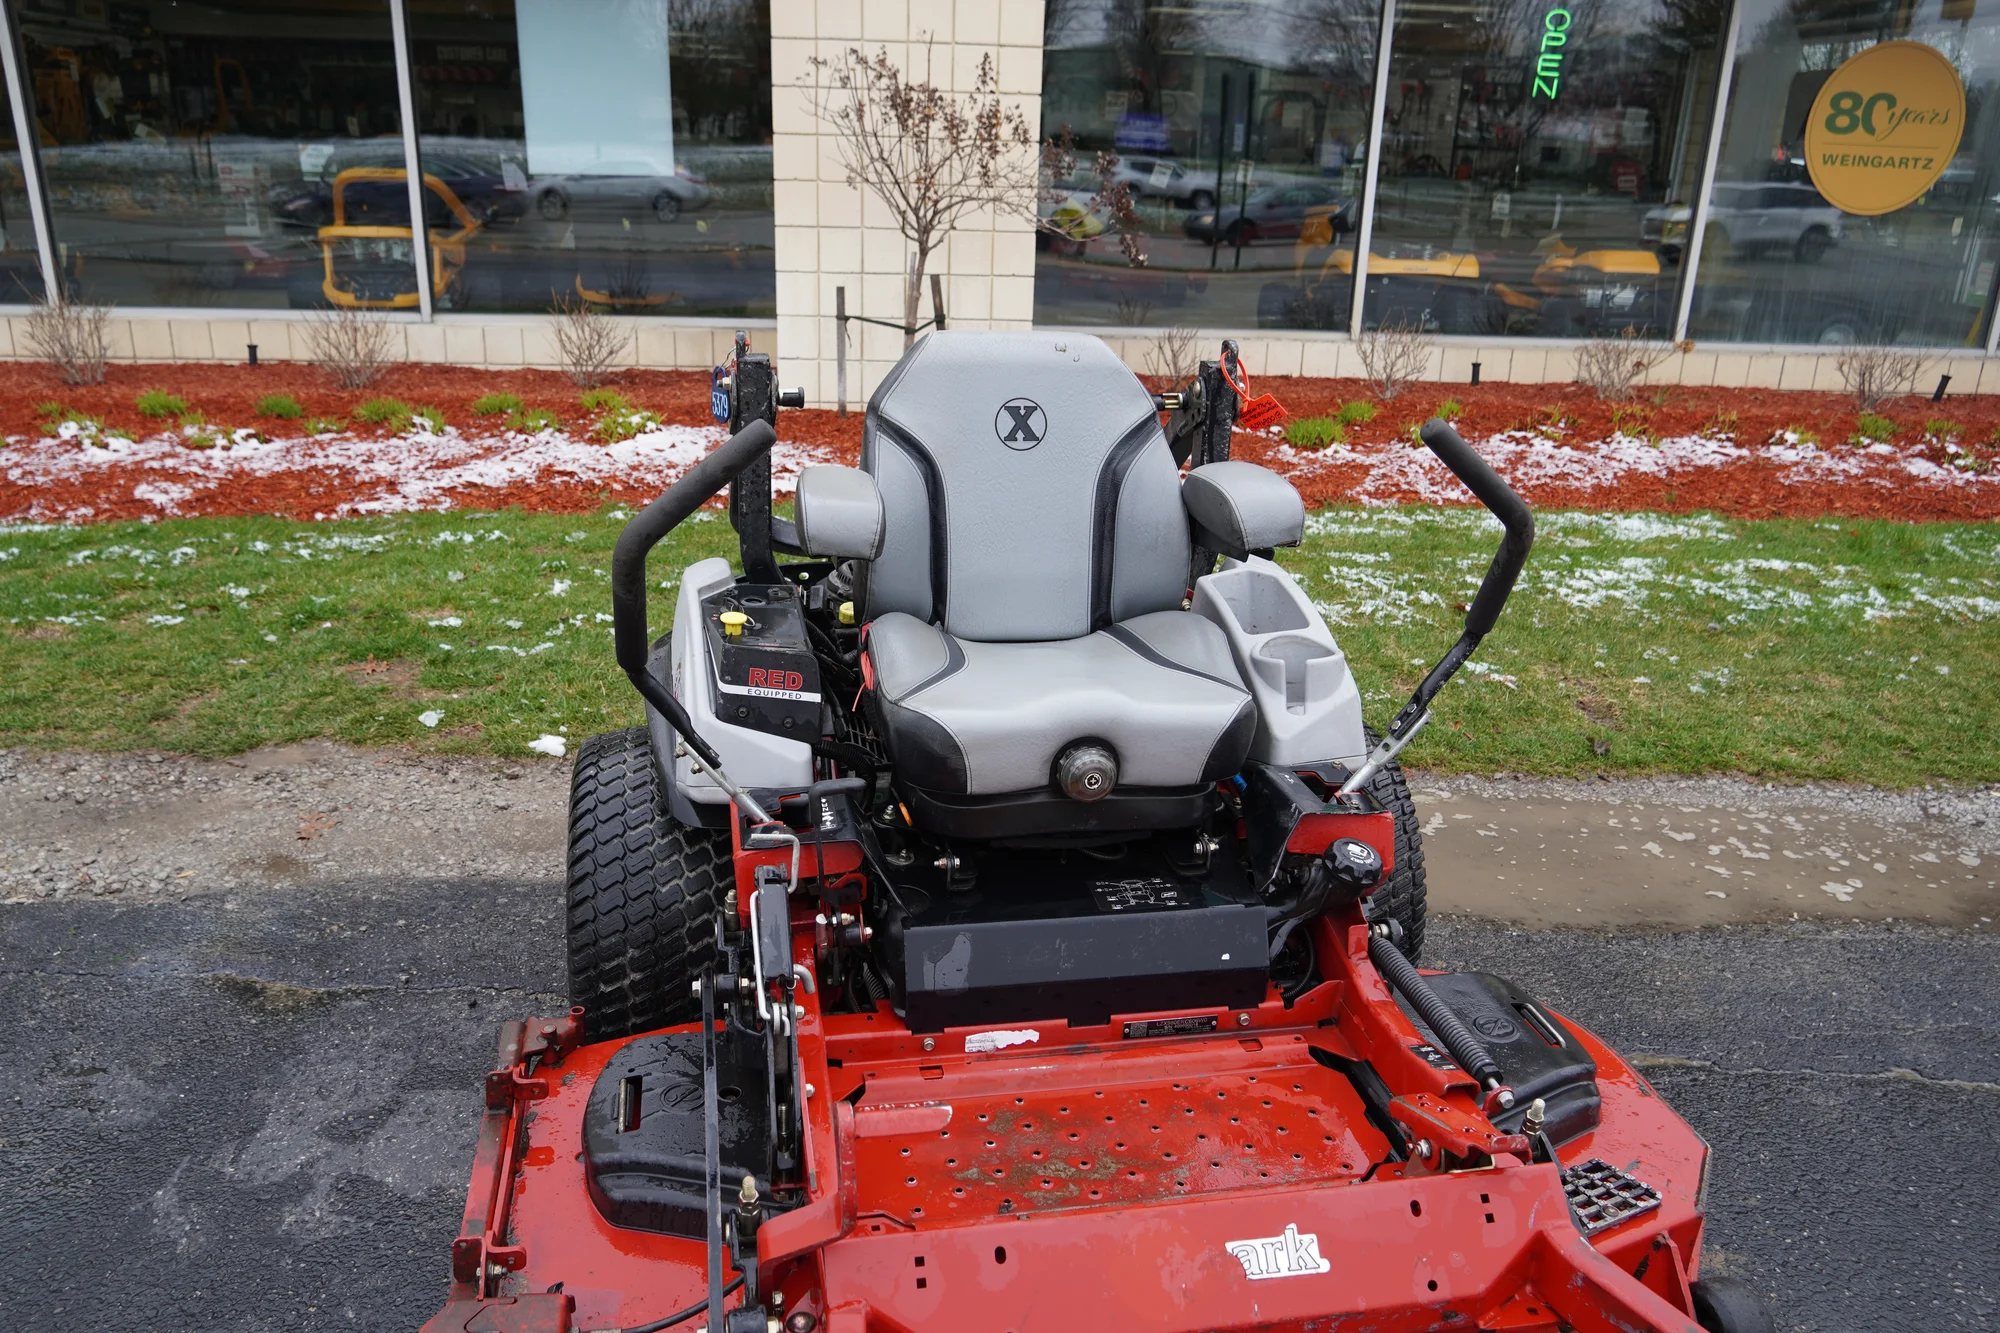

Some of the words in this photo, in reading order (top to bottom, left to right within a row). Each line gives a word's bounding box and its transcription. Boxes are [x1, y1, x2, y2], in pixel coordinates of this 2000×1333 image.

[1532, 8, 1571, 99] OPEN
[1825, 91, 1897, 136] 80
[1876, 107, 1950, 142] years
[1822, 153, 1934, 170] WEINGARTZ
[712, 391, 728, 418] 5379
[1003, 405, 1040, 442] X
[748, 667, 803, 690] RED
[747, 688, 802, 700] EQUIPPED
